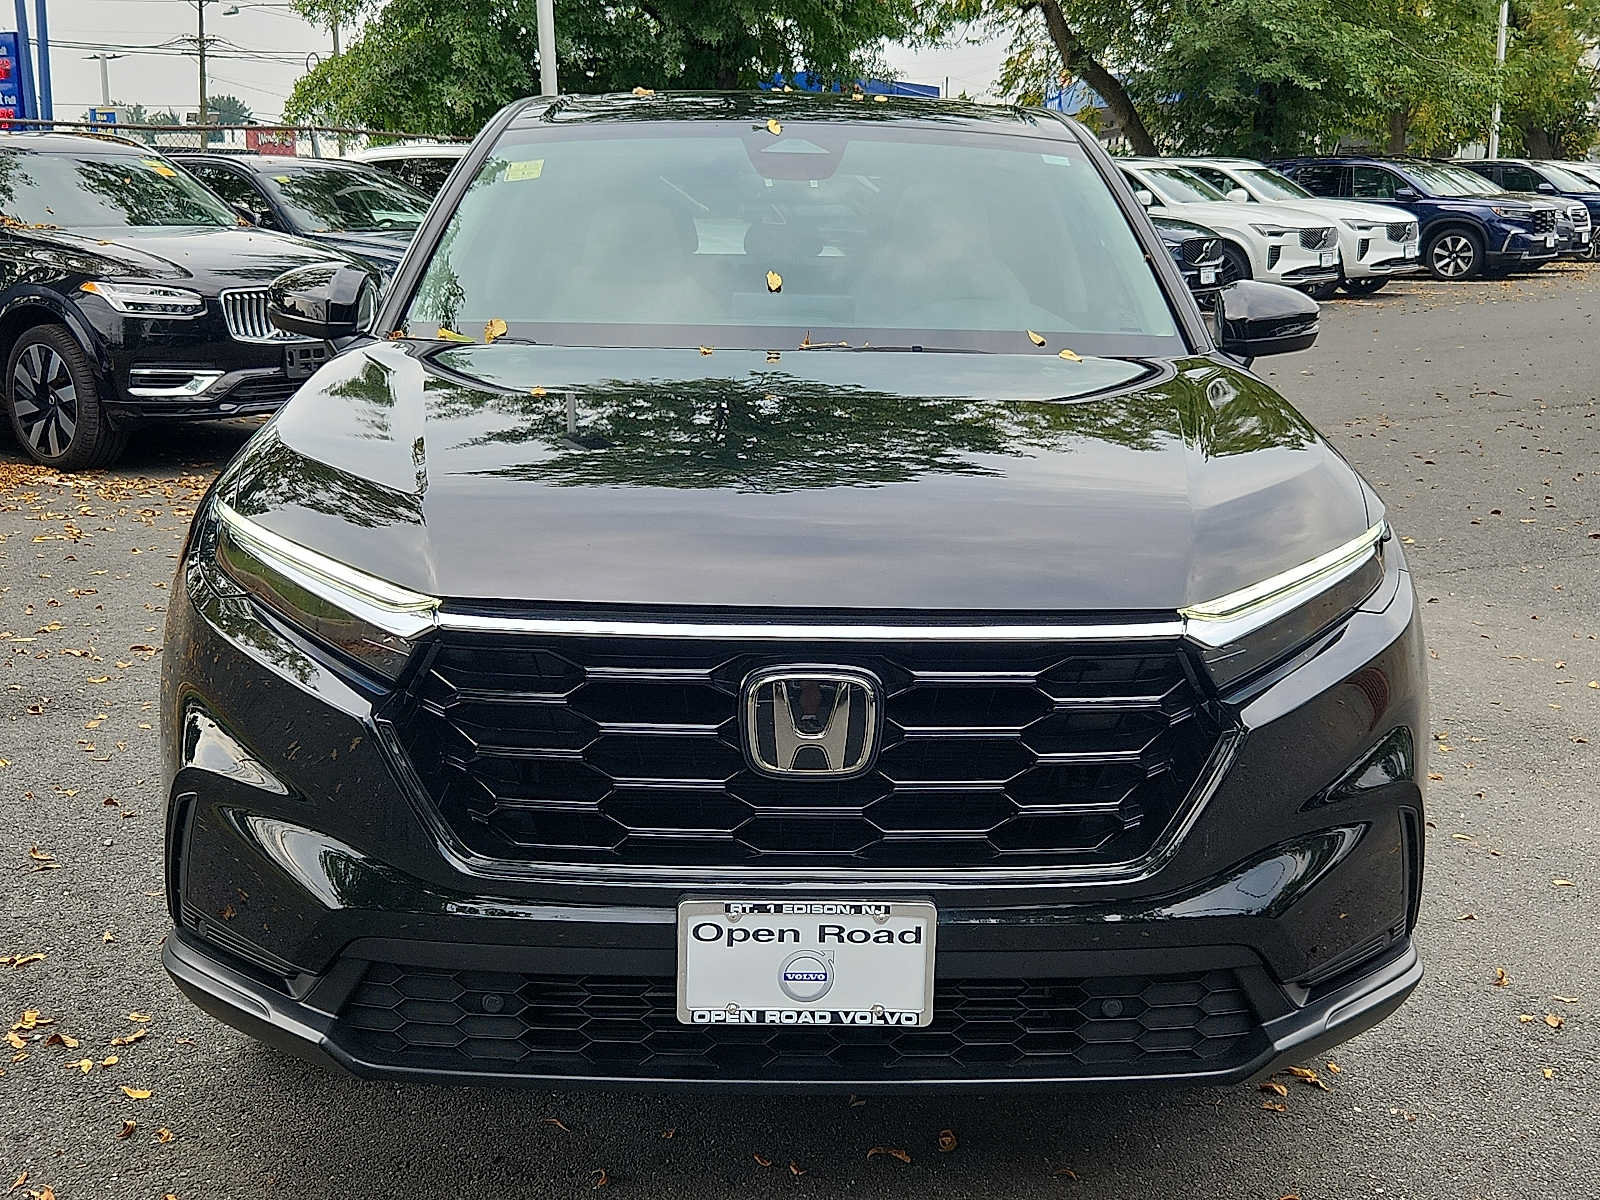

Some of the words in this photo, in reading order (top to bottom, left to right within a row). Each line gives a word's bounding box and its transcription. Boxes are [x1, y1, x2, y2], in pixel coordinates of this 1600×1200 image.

[766, 904, 775, 914] 1
[861, 904, 886, 915] NJ
[692, 922, 800, 948] Open
[818, 925, 922, 944] Road
[785, 973, 826, 982] VOLVO
[693, 1010, 757, 1023] OPEN
[765, 1010, 831, 1024] ROAD
[838, 1011, 918, 1025] VOLVO
